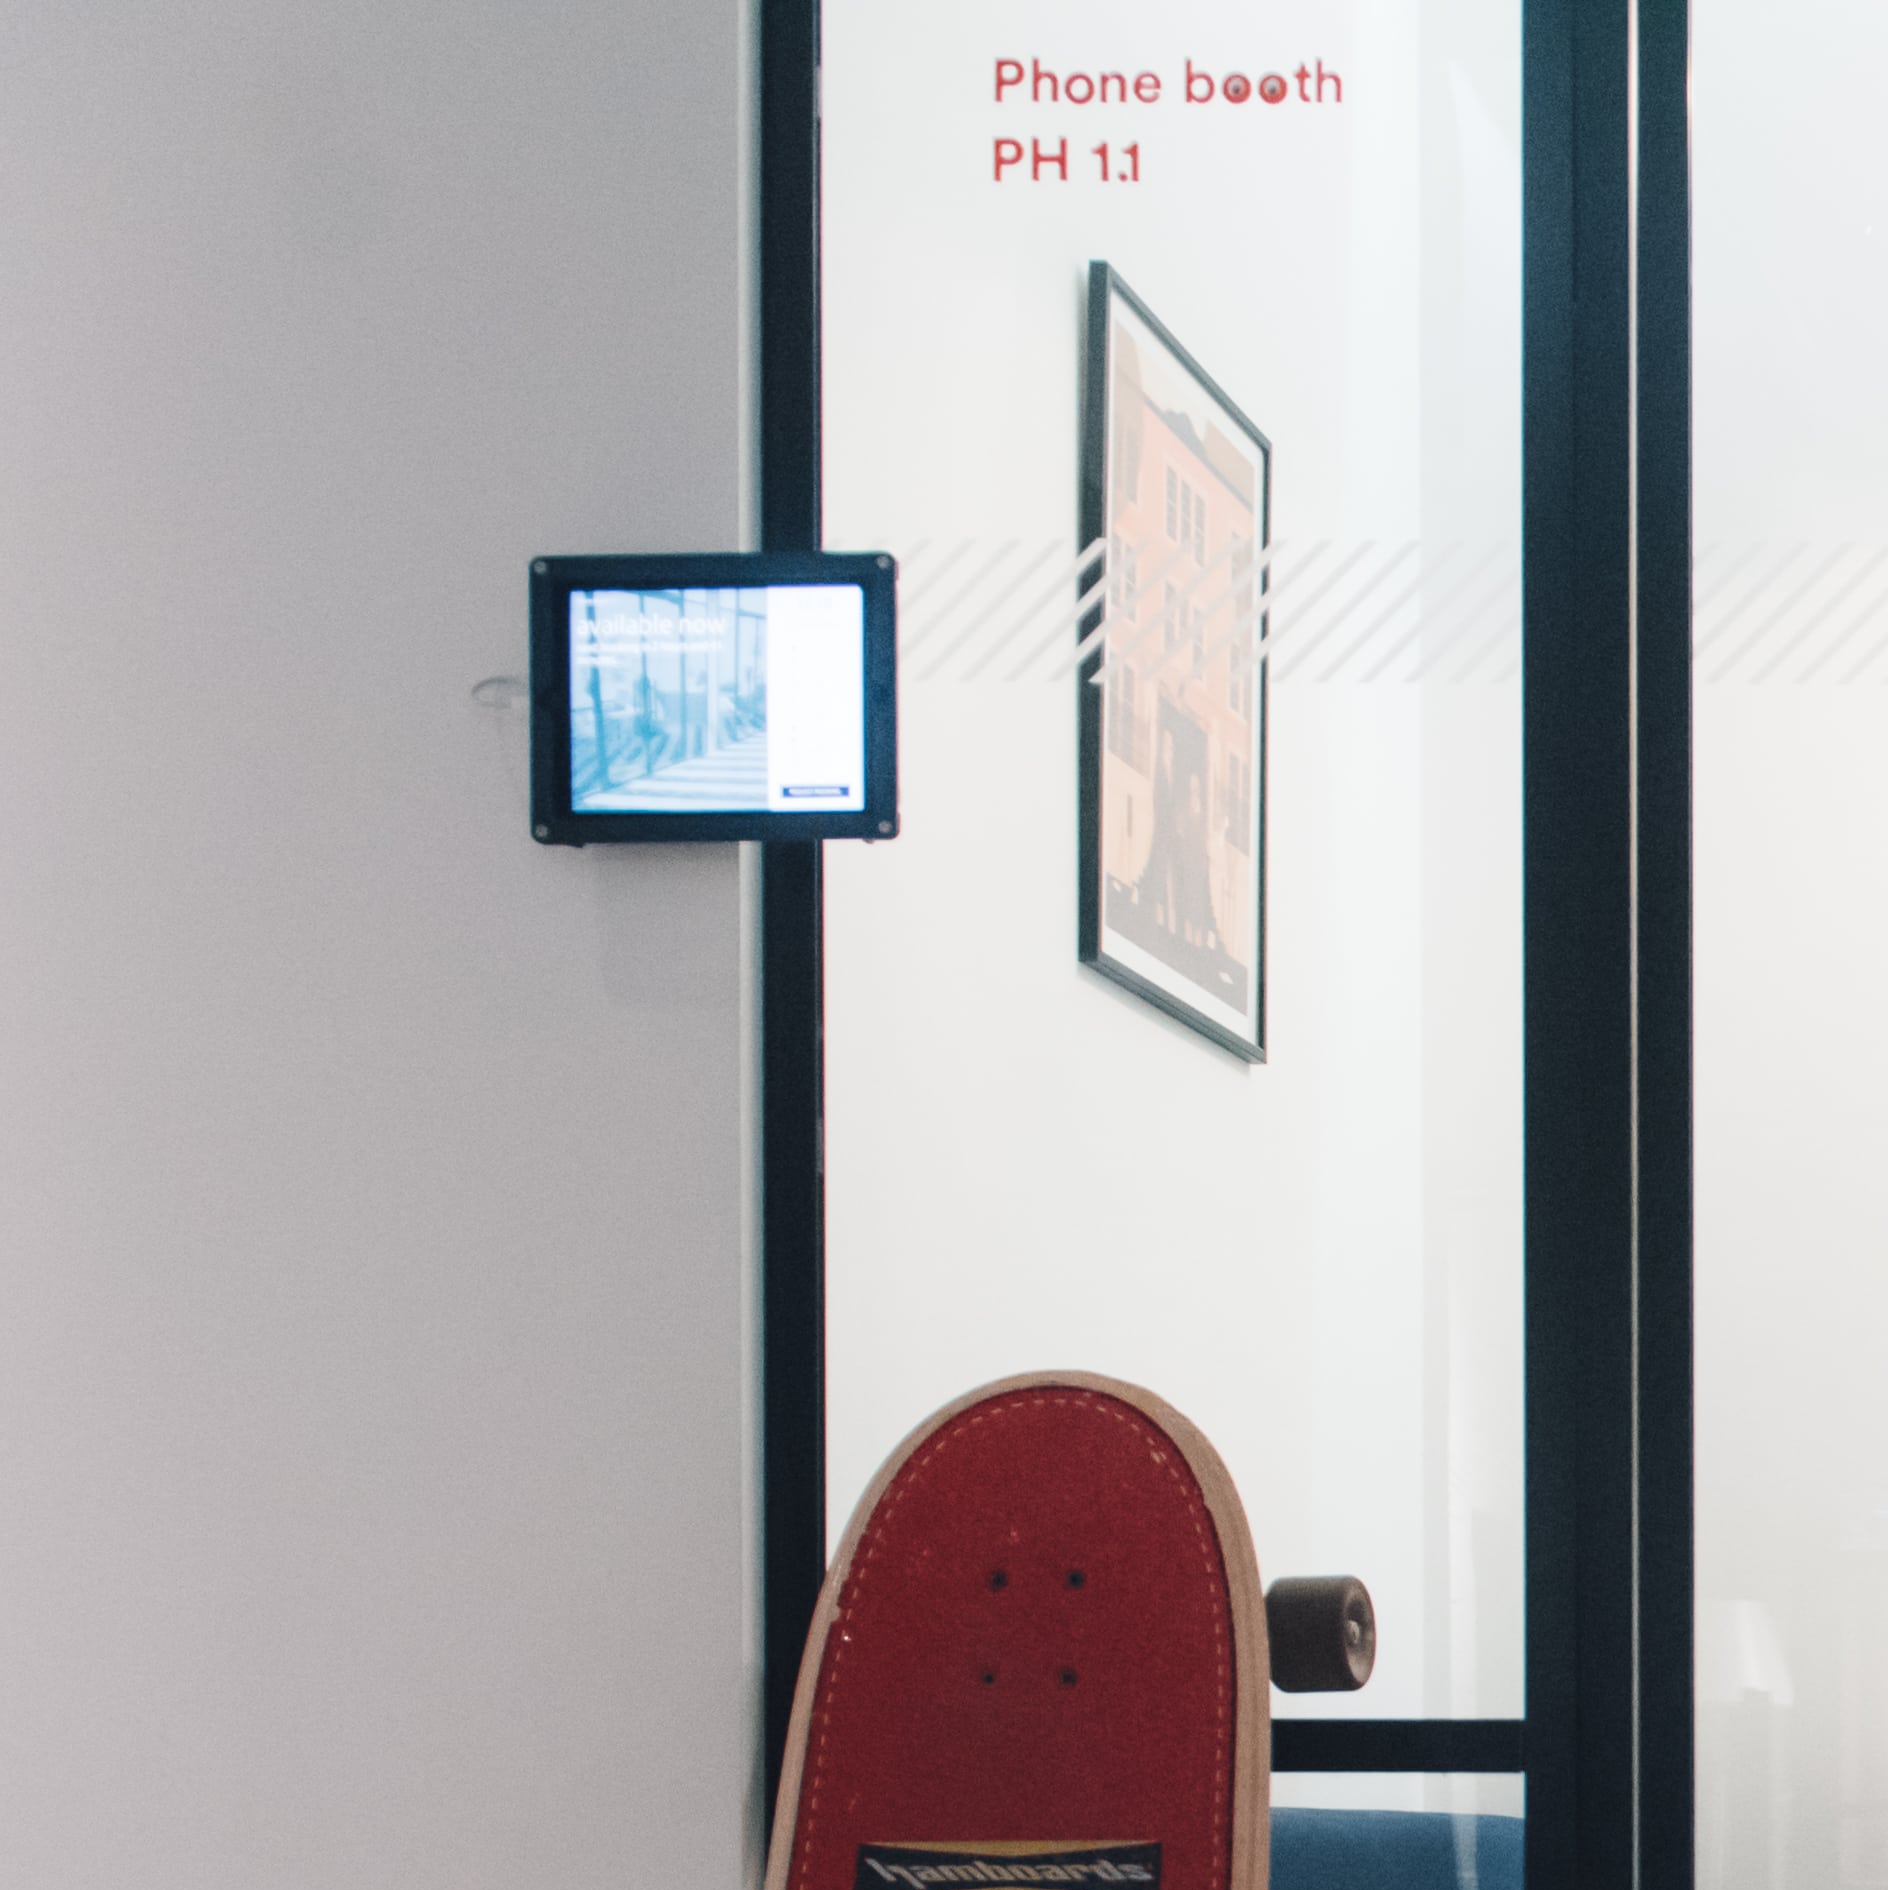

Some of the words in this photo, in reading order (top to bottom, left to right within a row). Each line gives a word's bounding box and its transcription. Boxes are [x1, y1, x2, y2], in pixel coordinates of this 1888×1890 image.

[994, 57, 1162, 105] Phone
[1184, 57, 1343, 104] booth
[993, 136, 1068, 182] PH
[1091, 141, 1140, 182] 1.1
[576, 613, 673, 635] available
[679, 616, 725, 634] now
